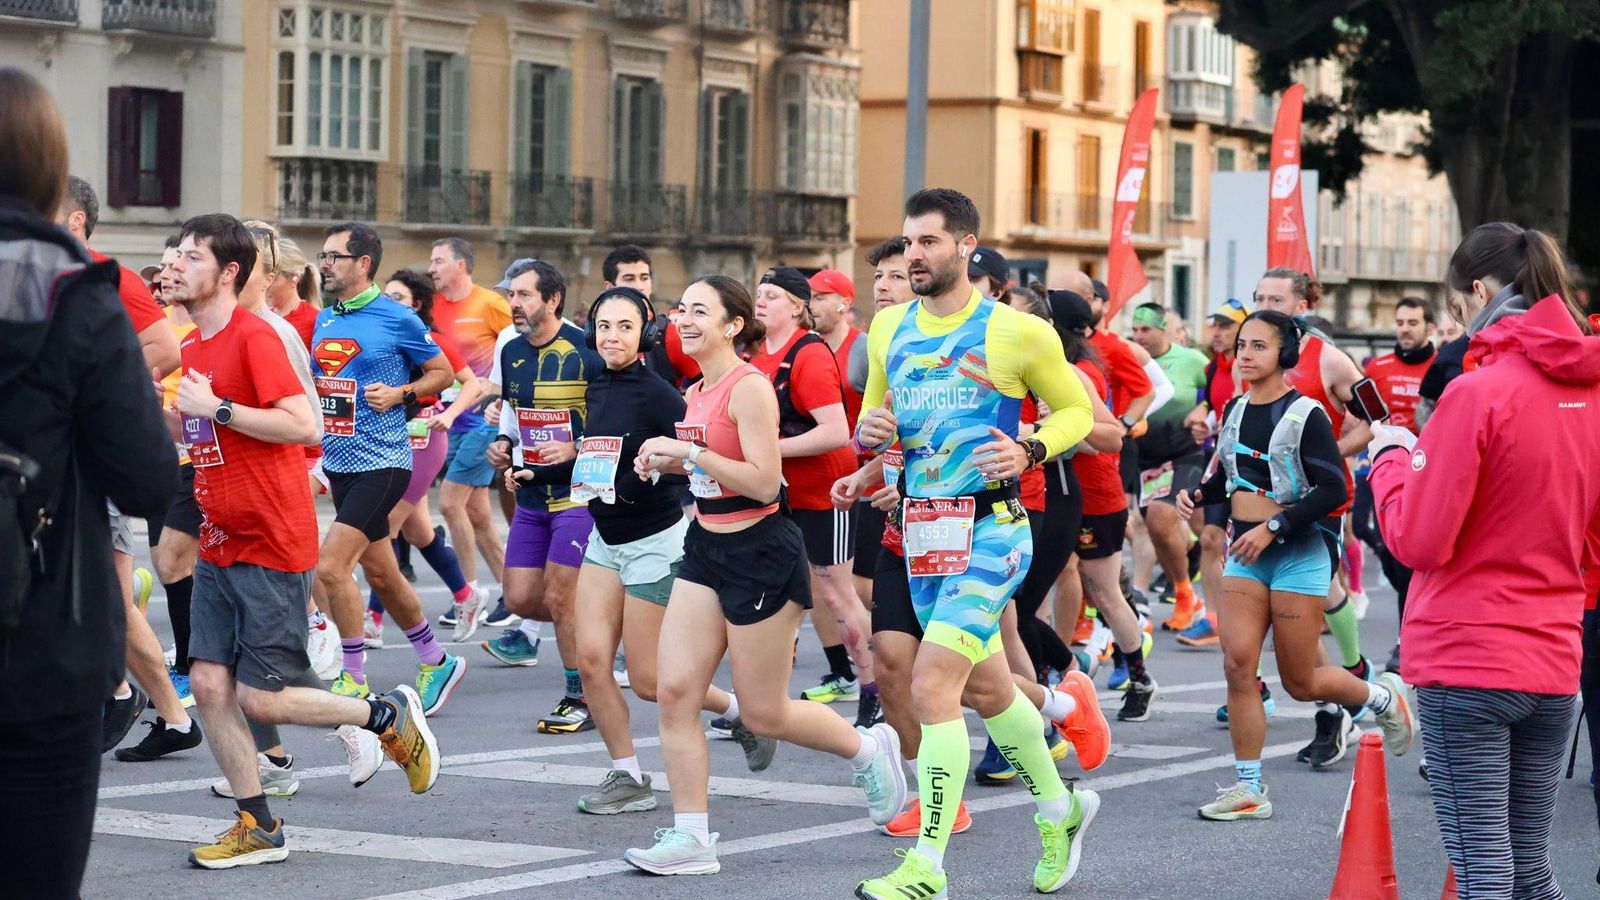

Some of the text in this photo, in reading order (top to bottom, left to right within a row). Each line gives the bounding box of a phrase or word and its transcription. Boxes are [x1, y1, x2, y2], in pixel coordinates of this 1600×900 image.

[529, 412, 566, 421] GENERALI
[530, 429, 554, 441] 5251
[919, 525, 949, 540] 4553
[923, 766, 951, 840] Kalenji
